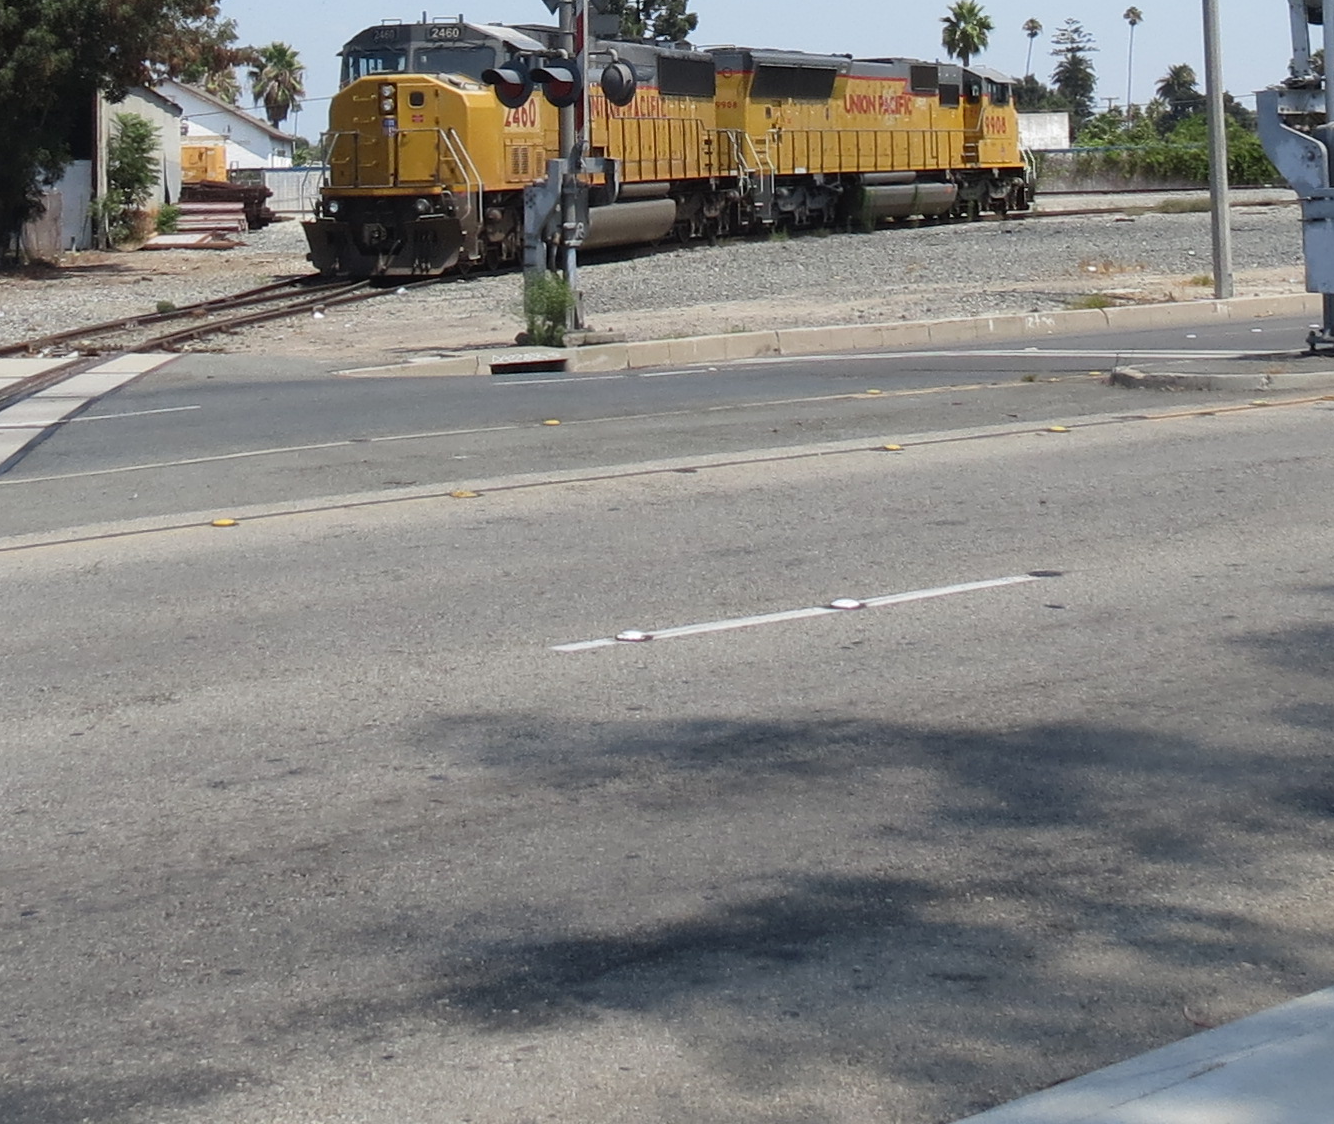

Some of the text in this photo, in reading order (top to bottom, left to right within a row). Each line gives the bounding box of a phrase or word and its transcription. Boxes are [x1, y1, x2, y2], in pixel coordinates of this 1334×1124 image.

[431, 27, 460, 38] 2460
[504, 98, 537, 127] 2460
[843, 94, 912, 116] UNION PACIFIC
